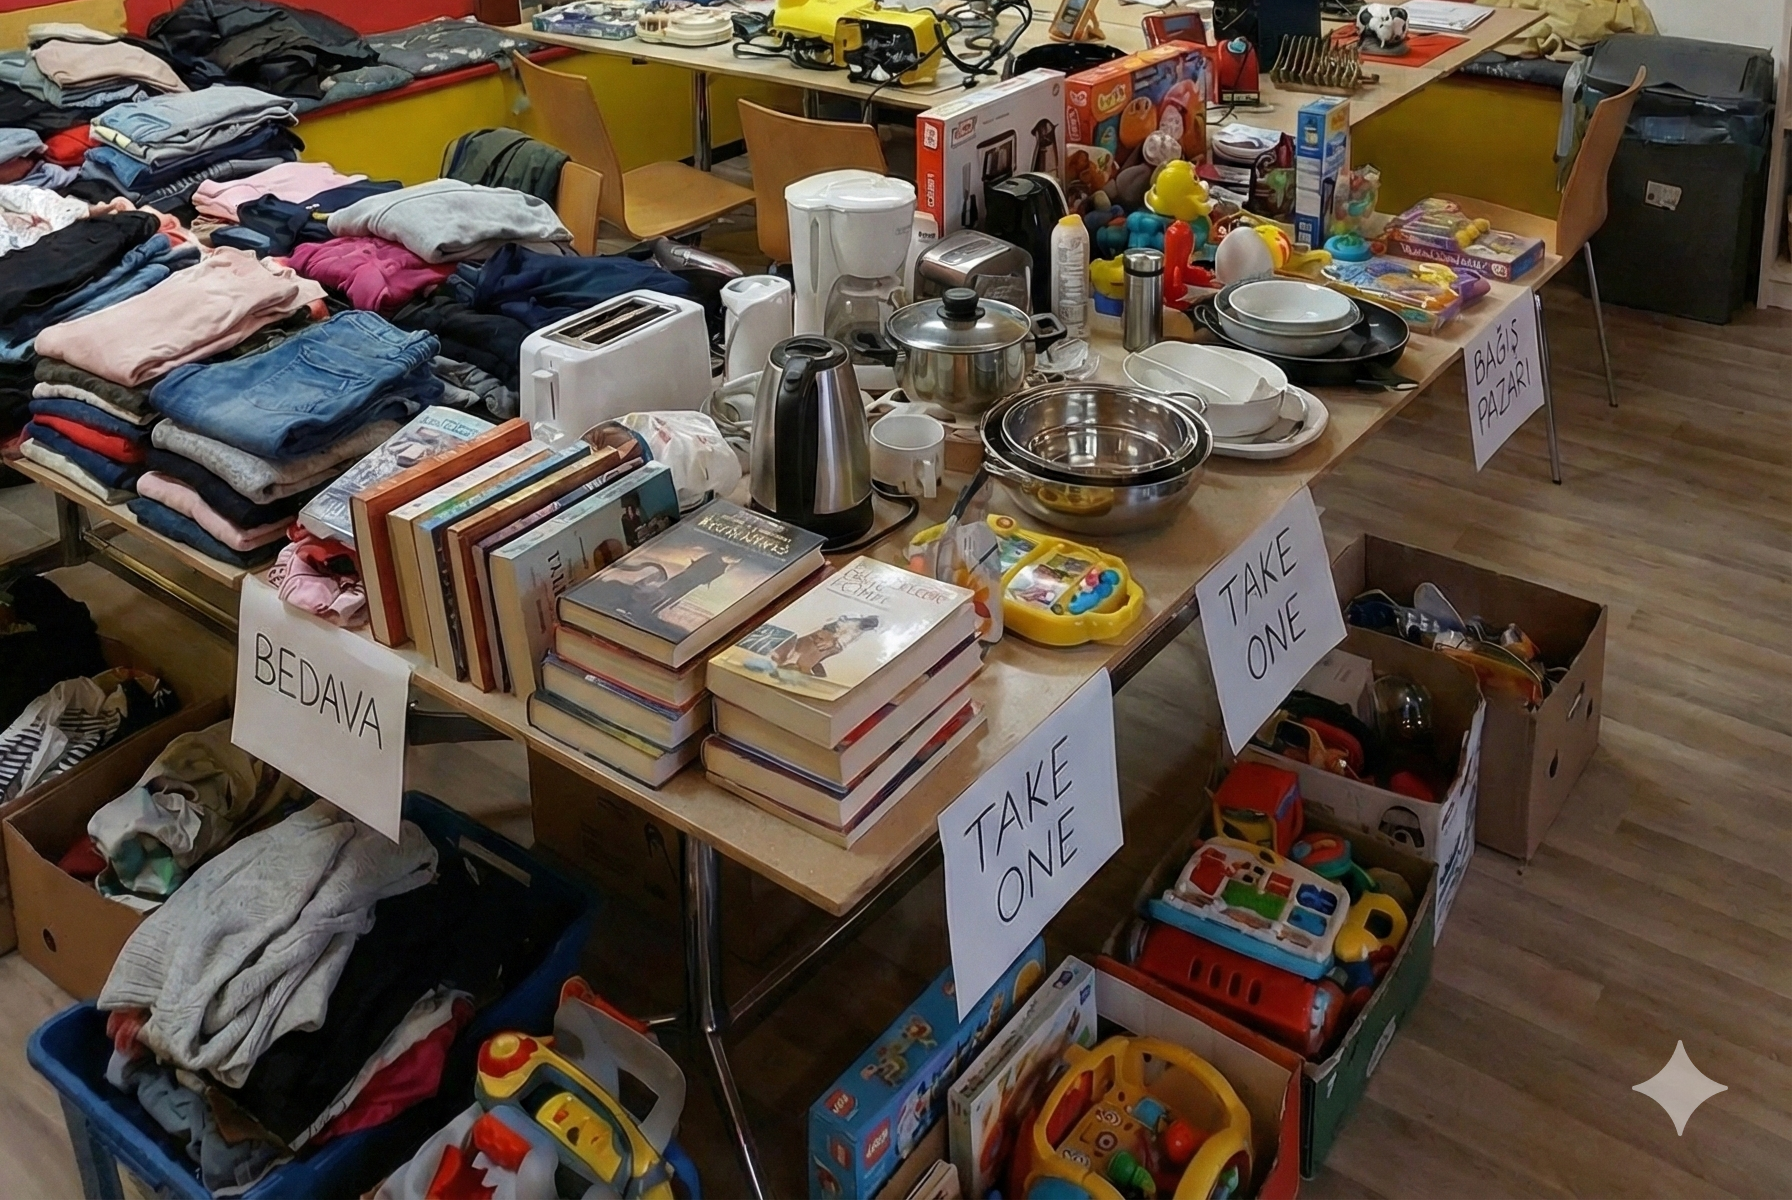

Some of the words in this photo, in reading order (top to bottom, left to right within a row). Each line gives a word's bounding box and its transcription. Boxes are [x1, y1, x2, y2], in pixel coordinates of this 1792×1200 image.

[1473, 318, 1519, 387] BAĞIŞ
[1477, 357, 1532, 437] PAZARI
[1218, 526, 1299, 627] TAKE
[1246, 592, 1307, 681] ONE
[253, 632, 383, 750] BEDAVA
[963, 734, 1073, 873] TAKE
[996, 806, 1079, 923] ONE
